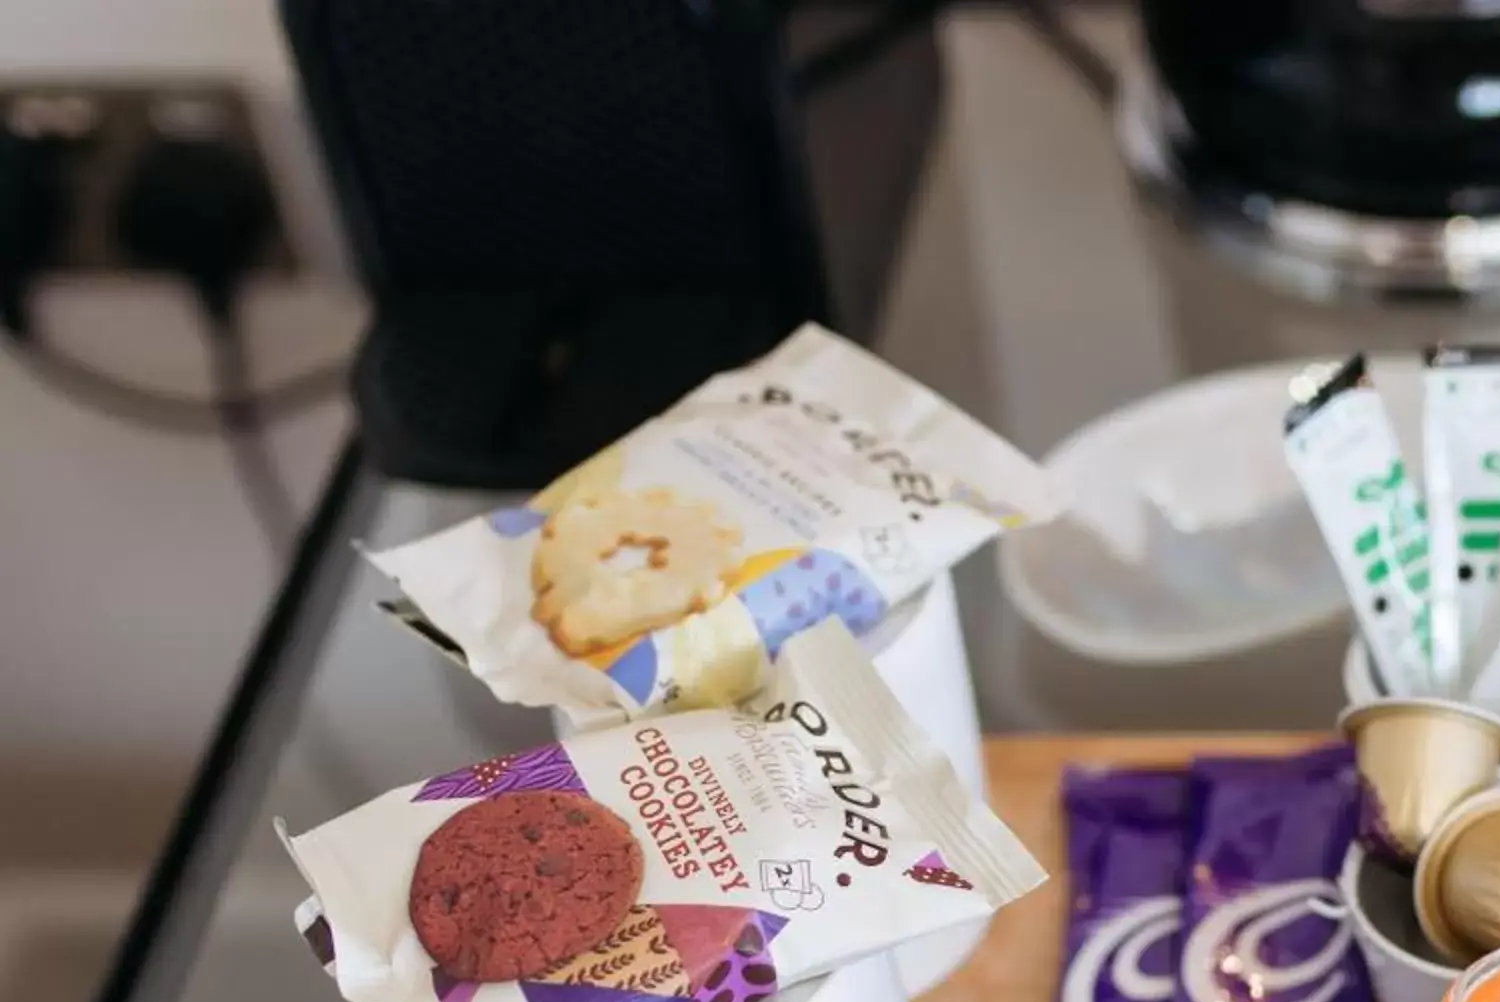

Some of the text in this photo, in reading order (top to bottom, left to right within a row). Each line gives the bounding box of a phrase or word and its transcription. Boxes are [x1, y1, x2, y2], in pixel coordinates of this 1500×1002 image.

[620, 765, 701, 879] COOKIES
[634, 727, 750, 893] CHOCOLATEY
[688, 755, 748, 836] DIVINELY
